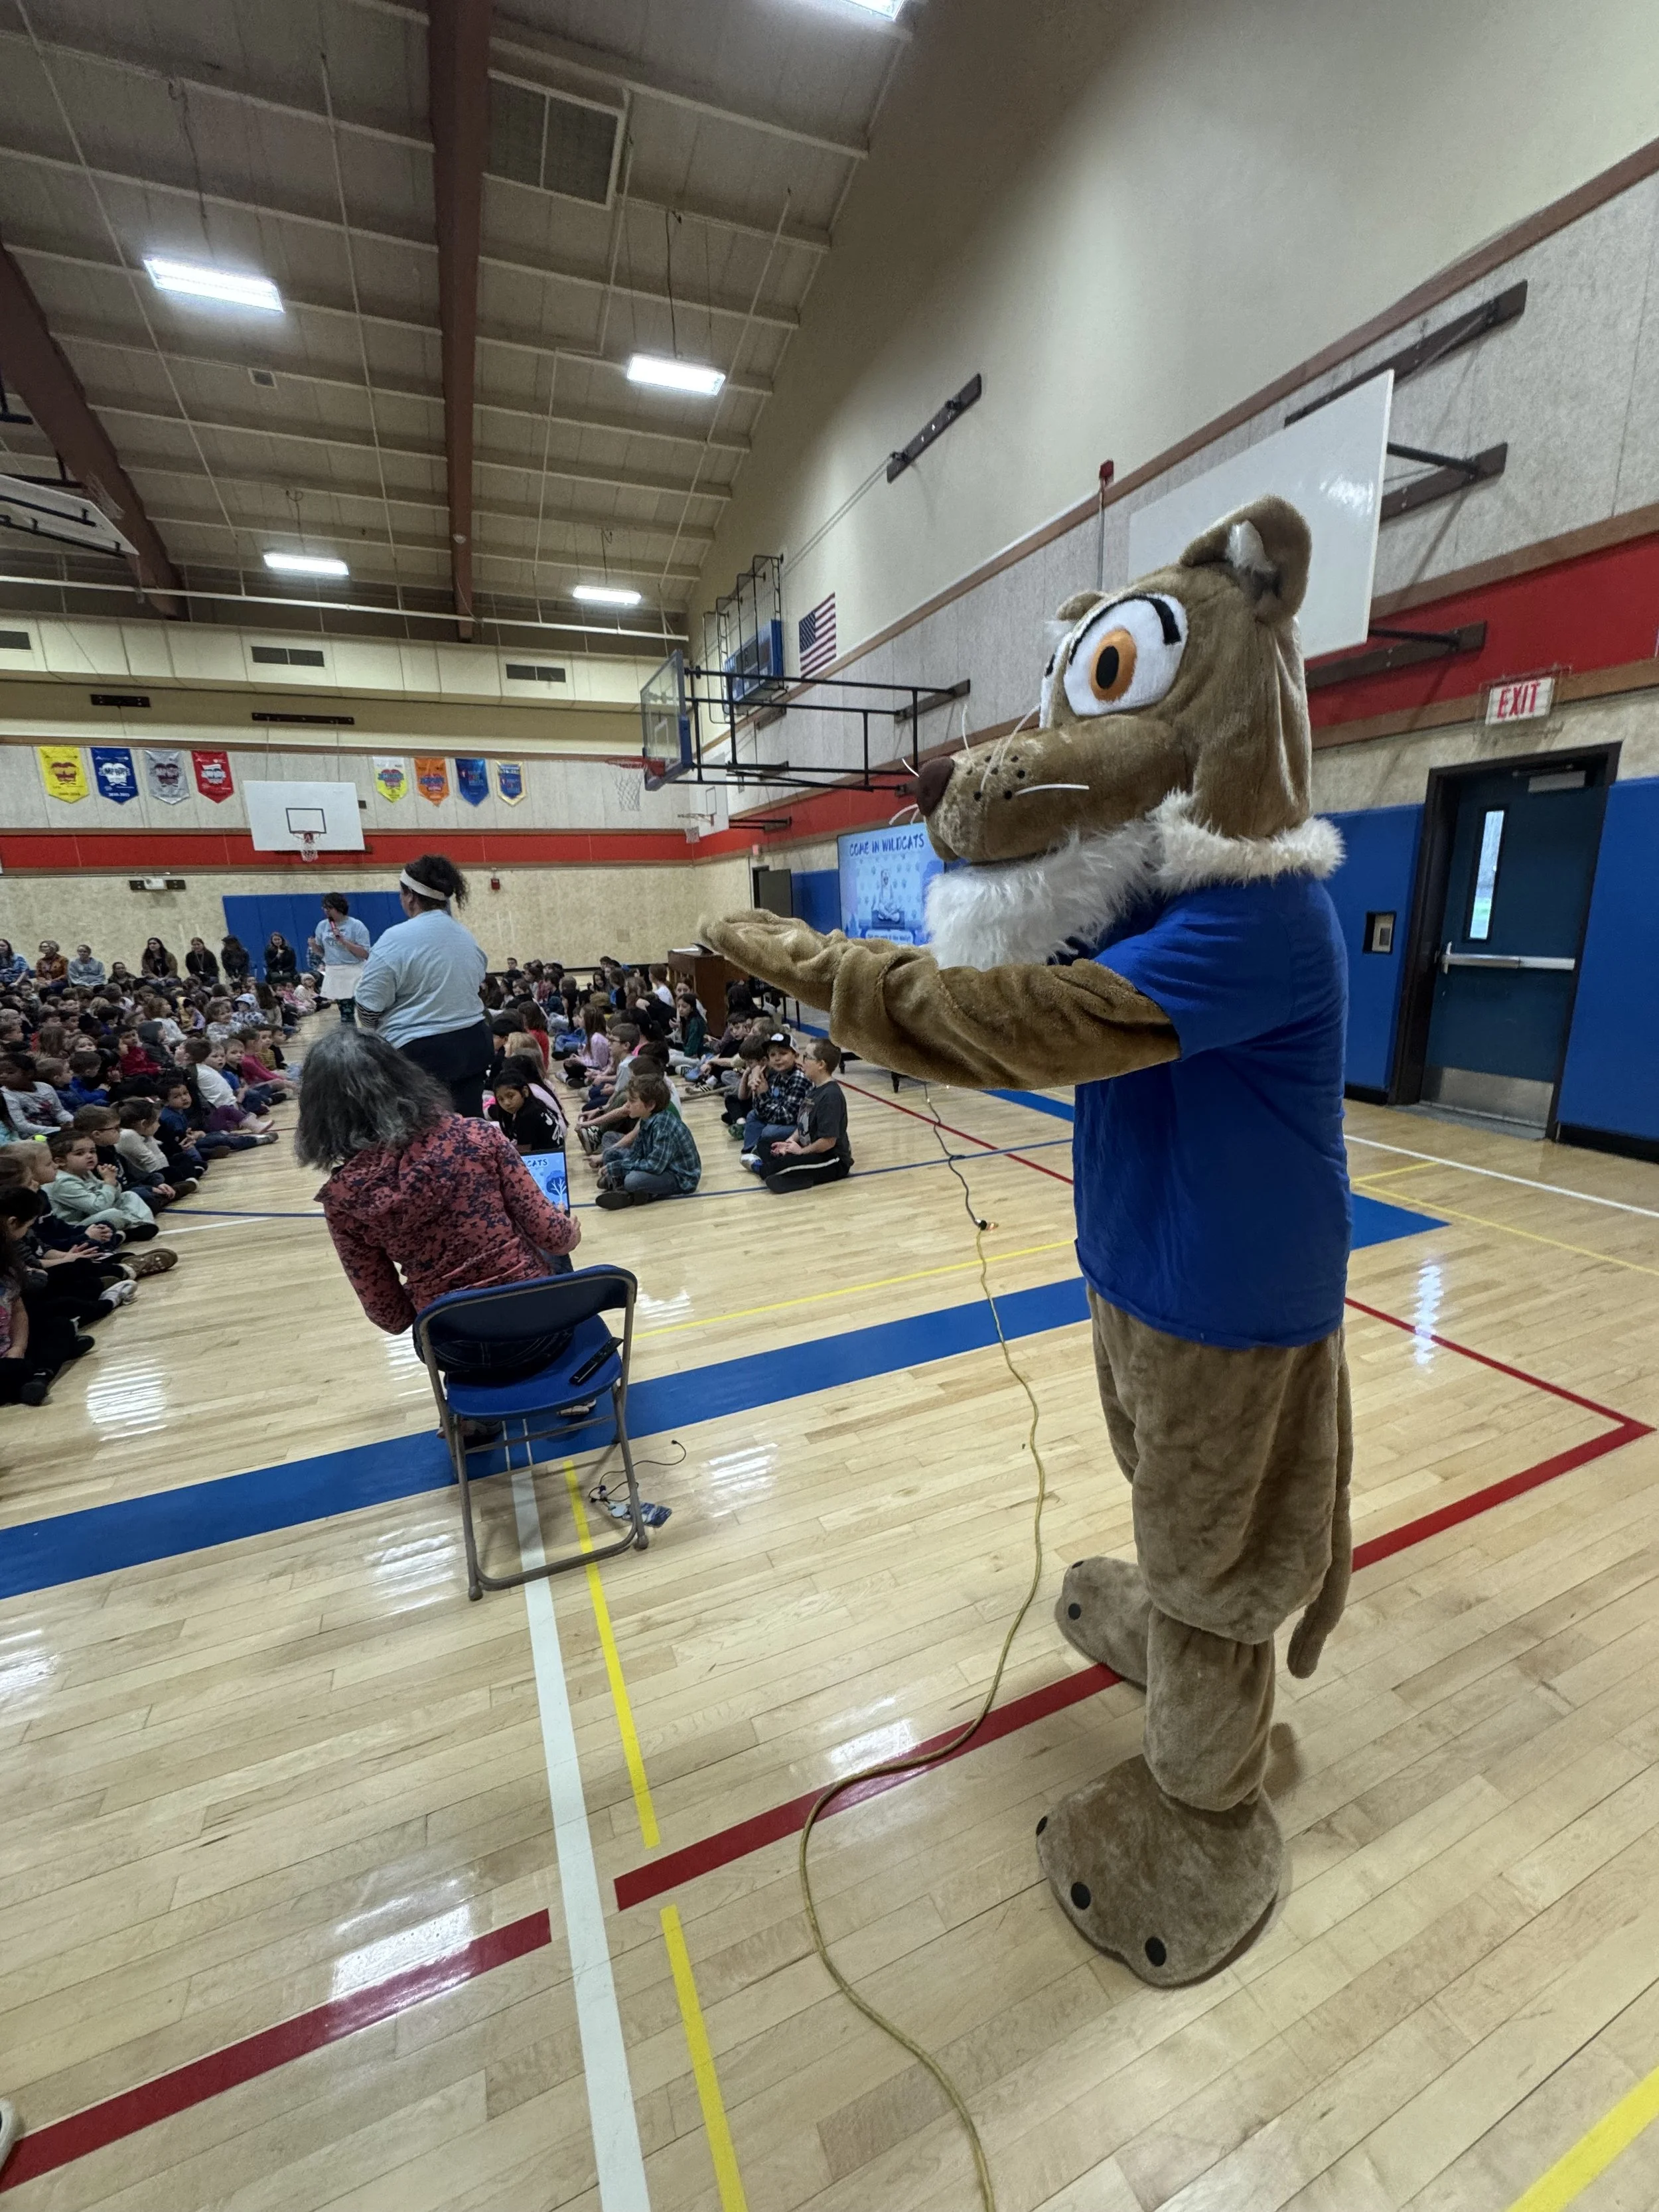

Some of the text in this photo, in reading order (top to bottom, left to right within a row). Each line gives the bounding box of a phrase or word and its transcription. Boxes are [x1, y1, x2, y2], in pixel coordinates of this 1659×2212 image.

[1497, 682, 1540, 719] EXIT
[849, 833, 924, 856] COME IN WILDCATS
